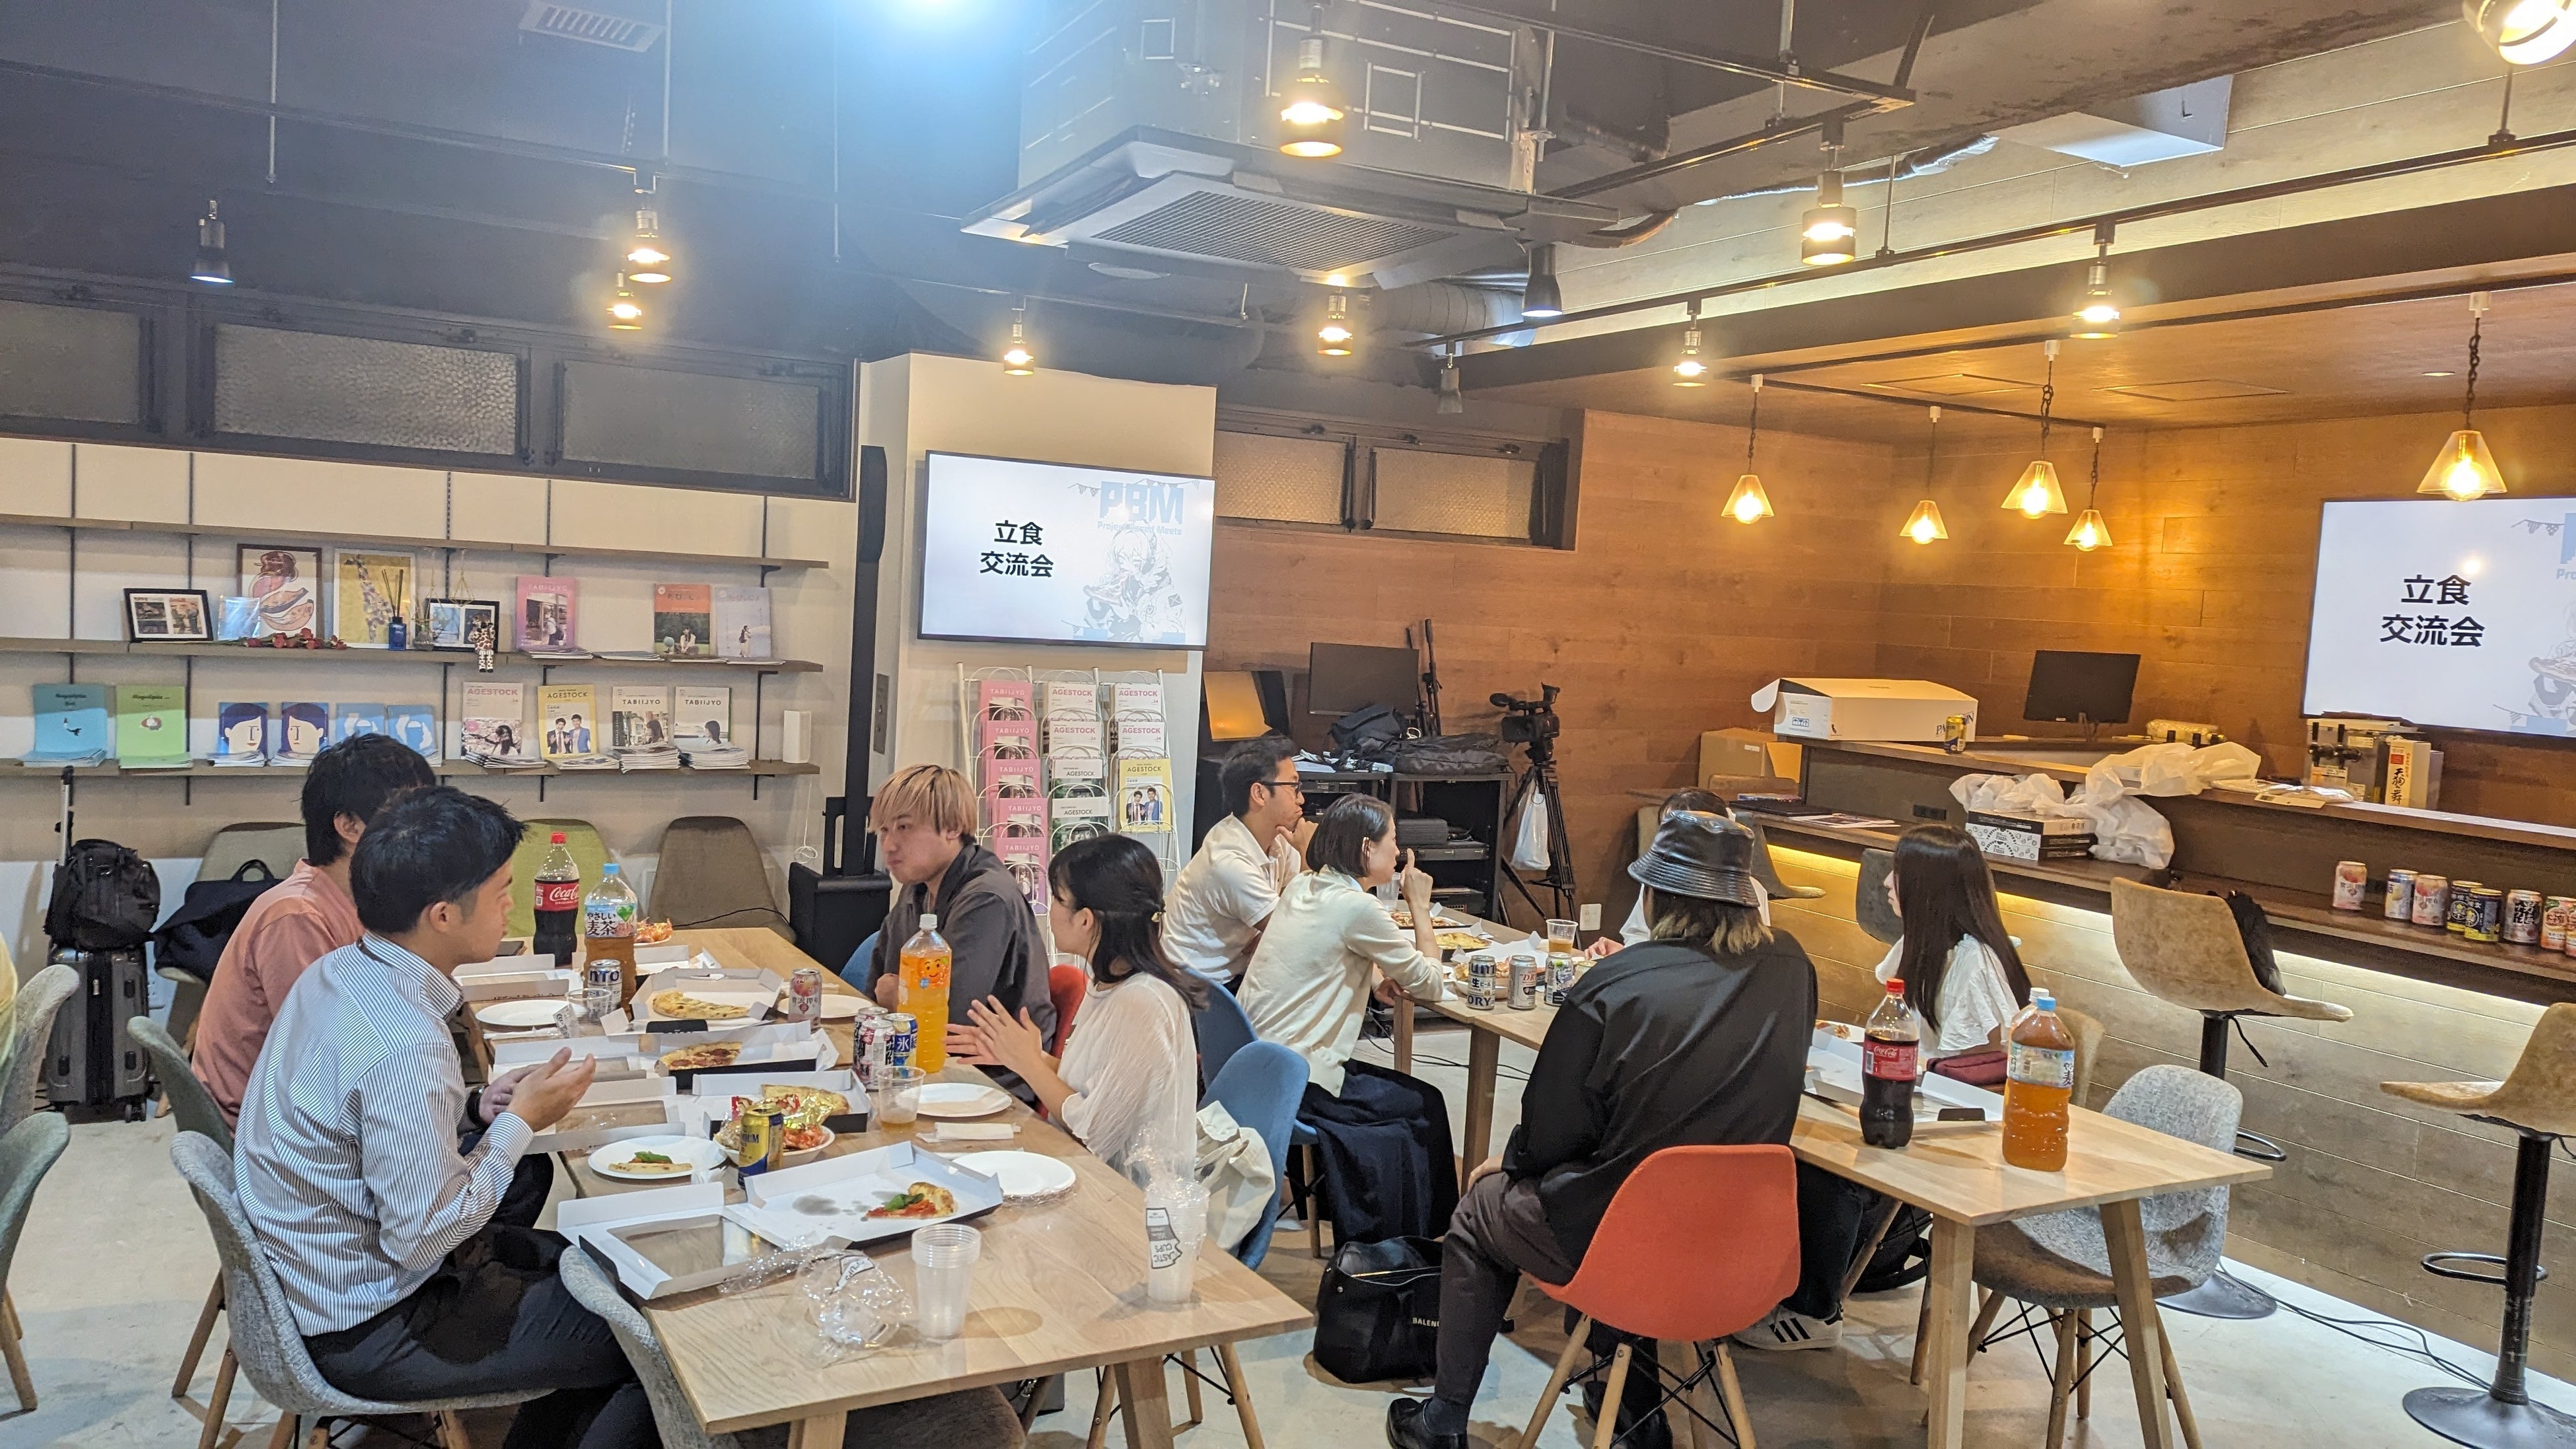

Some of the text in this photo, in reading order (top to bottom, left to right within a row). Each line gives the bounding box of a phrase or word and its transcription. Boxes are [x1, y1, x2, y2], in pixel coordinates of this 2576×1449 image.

[1100, 481, 1184, 524] PBM
[993, 520, 1044, 546] 立食
[1157, 526, 1182, 536] Meets
[979, 551, 1055, 578] 交流会
[2400, 574, 2472, 606] 立食
[2379, 614, 2486, 647] 交流会
[587, 921, 616, 935] 麦茶
[1155, 1243, 1172, 1252] CUPS
